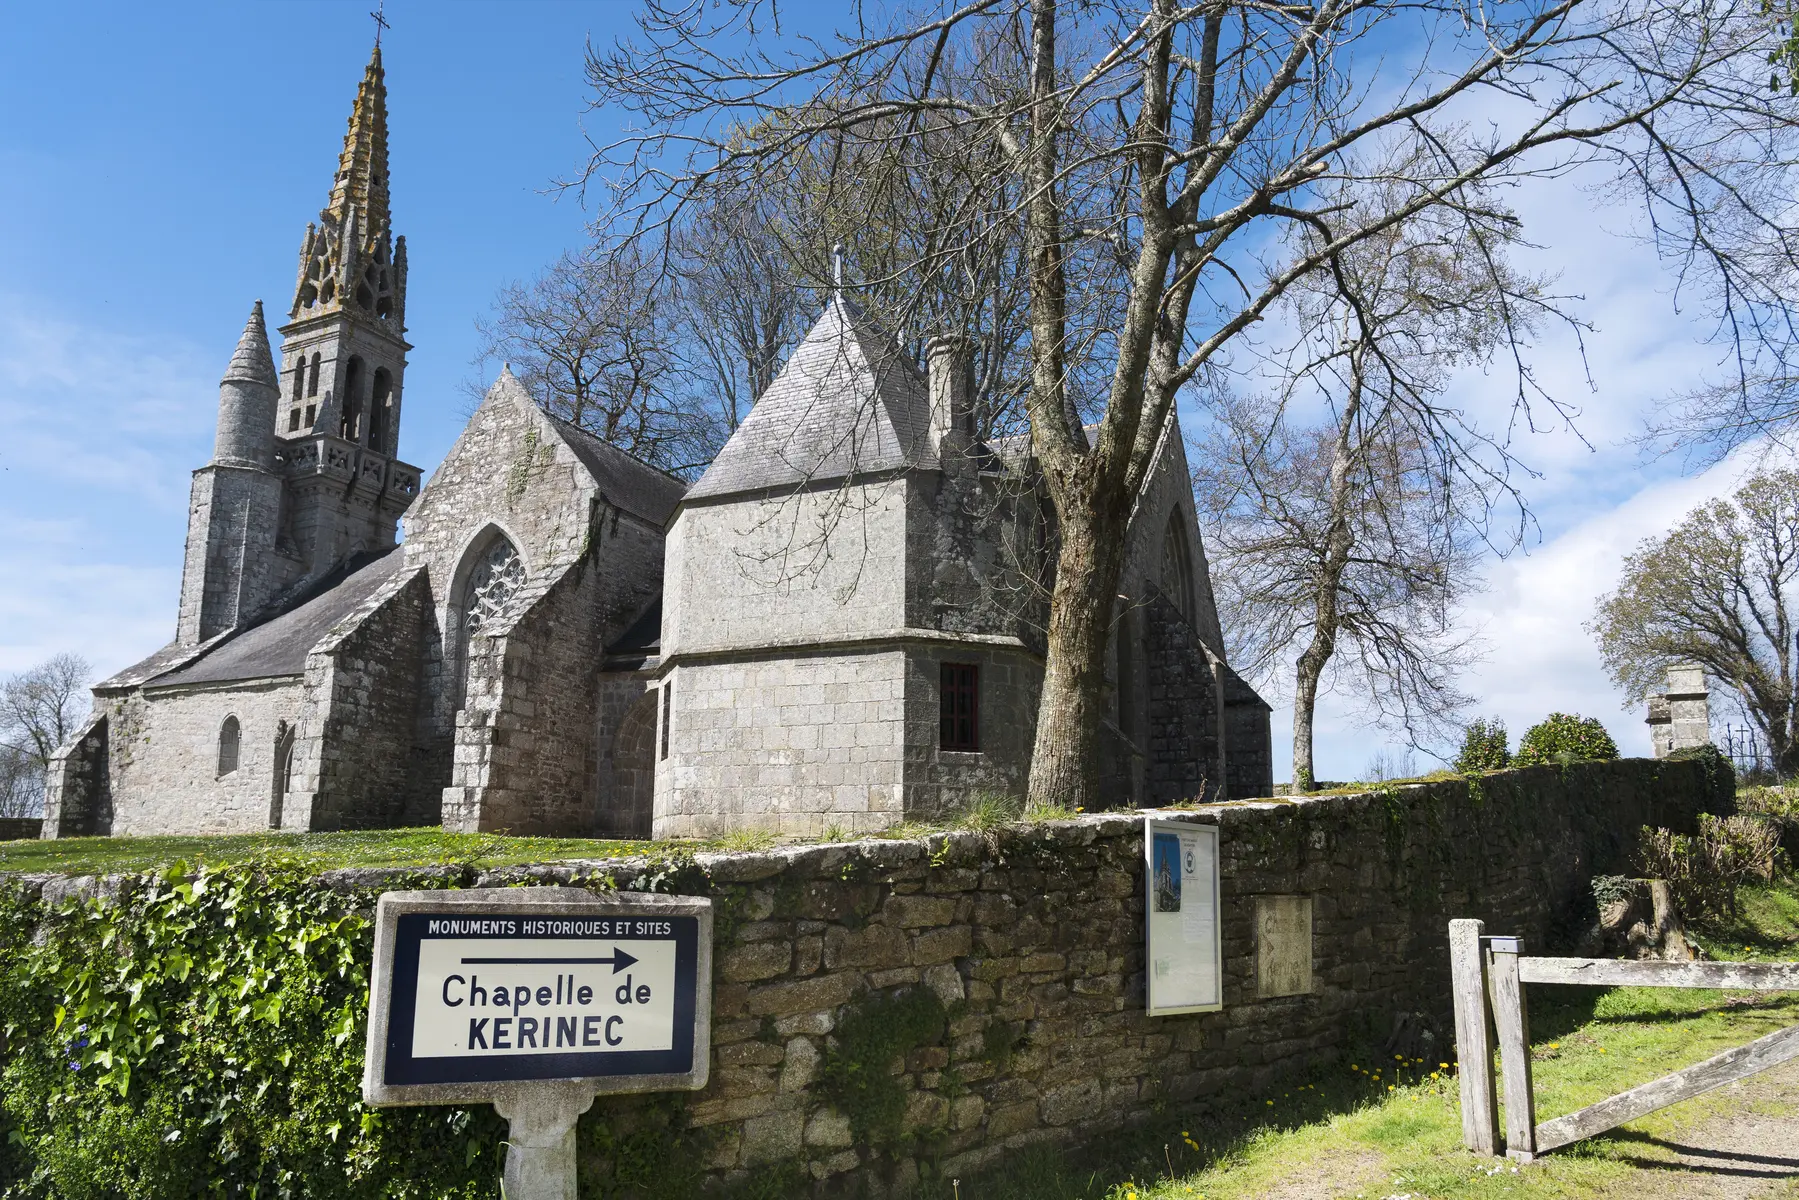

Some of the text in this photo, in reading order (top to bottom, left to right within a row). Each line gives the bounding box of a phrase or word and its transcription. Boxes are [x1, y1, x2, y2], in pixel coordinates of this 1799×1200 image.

[428, 920, 671, 936] MONUMENTS HISTORIQUES ET SITES
[442, 973, 651, 1017] Chapelle de
[468, 1015, 624, 1050] KERINEC
